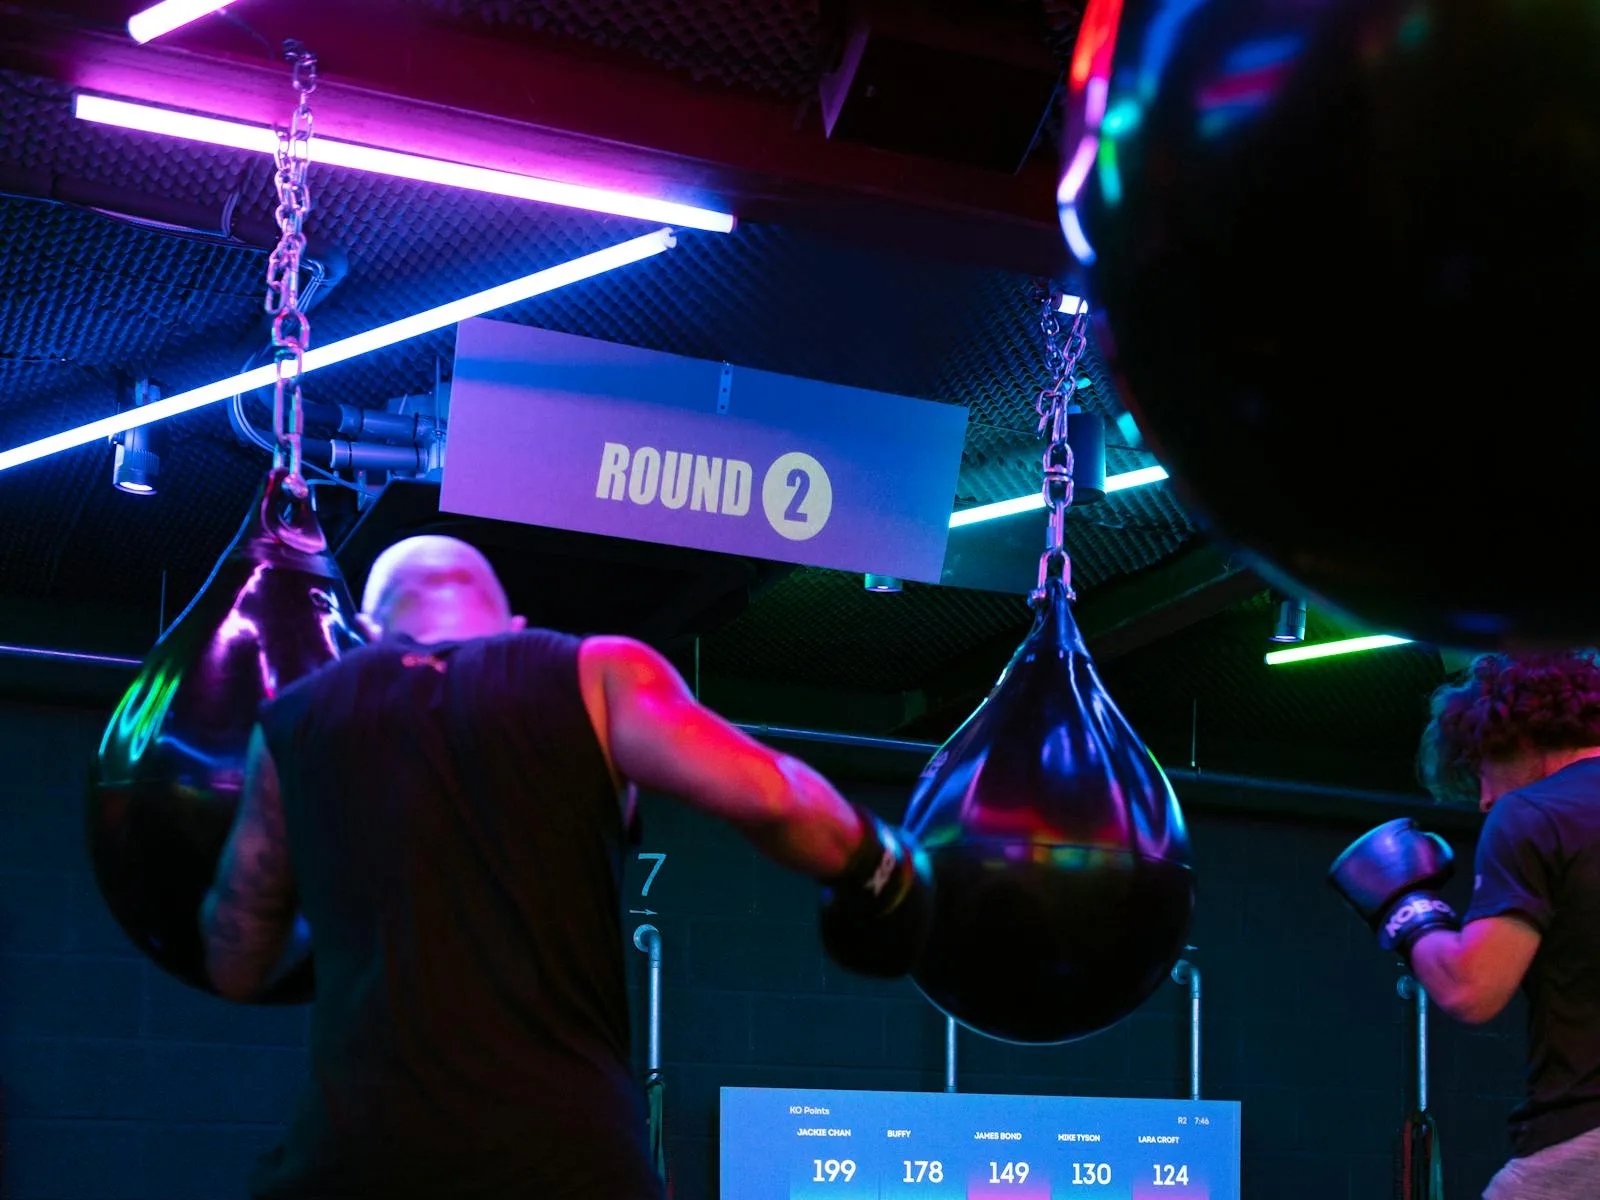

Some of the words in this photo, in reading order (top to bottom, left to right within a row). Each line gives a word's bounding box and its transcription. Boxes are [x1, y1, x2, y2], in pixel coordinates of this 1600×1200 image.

[596, 441, 753, 517] ROUND
[783, 467, 811, 524] 2
[638, 852, 667, 897] 7
[789, 1106, 803, 1115] KO
[804, 1106, 830, 1116] Points
[1177, 1116, 1188, 1125] R2
[797, 1128, 827, 1137] JACKIE
[828, 1129, 852, 1137] CHAN
[887, 1130, 911, 1138] BUFFY
[974, 1132, 999, 1140] JAMES
[1000, 1132, 1022, 1141] BOND
[1058, 1134, 1076, 1142] MIKE
[1077, 1134, 1101, 1142] TYSON
[1138, 1136, 1156, 1144] LARA
[1157, 1136, 1180, 1144] CROFT
[812, 1159, 857, 1182] 199
[903, 1160, 944, 1183] 178
[989, 1161, 1030, 1184] 149
[1072, 1162, 1112, 1185] 130
[1153, 1164, 1189, 1186] 124
